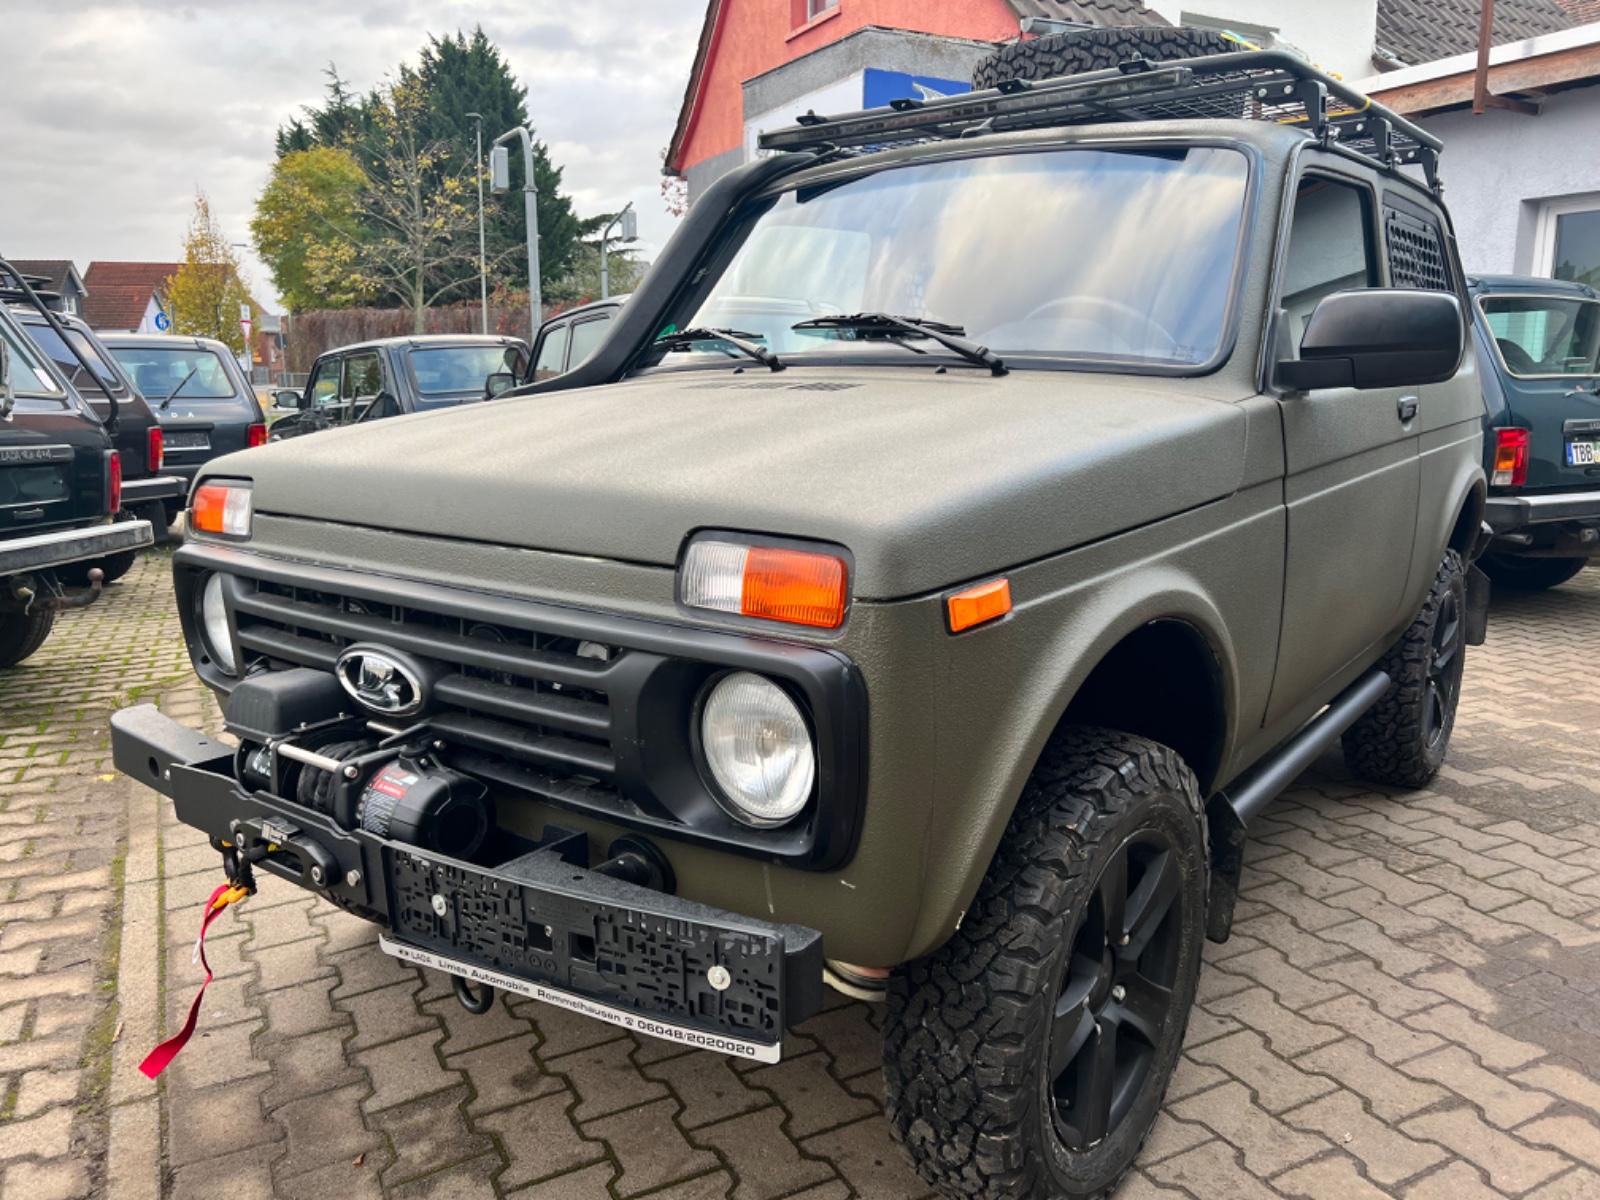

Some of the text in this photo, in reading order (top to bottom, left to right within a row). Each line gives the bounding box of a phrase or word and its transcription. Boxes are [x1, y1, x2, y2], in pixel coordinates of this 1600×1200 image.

[1573, 444, 1592, 462] TBB
[439, 960, 467, 974] Limes
[471, 969, 530, 993] Automobile
[537, 989, 621, 1021] Rommelhausen
[638, 1020, 755, 1055] 06048/2020020
